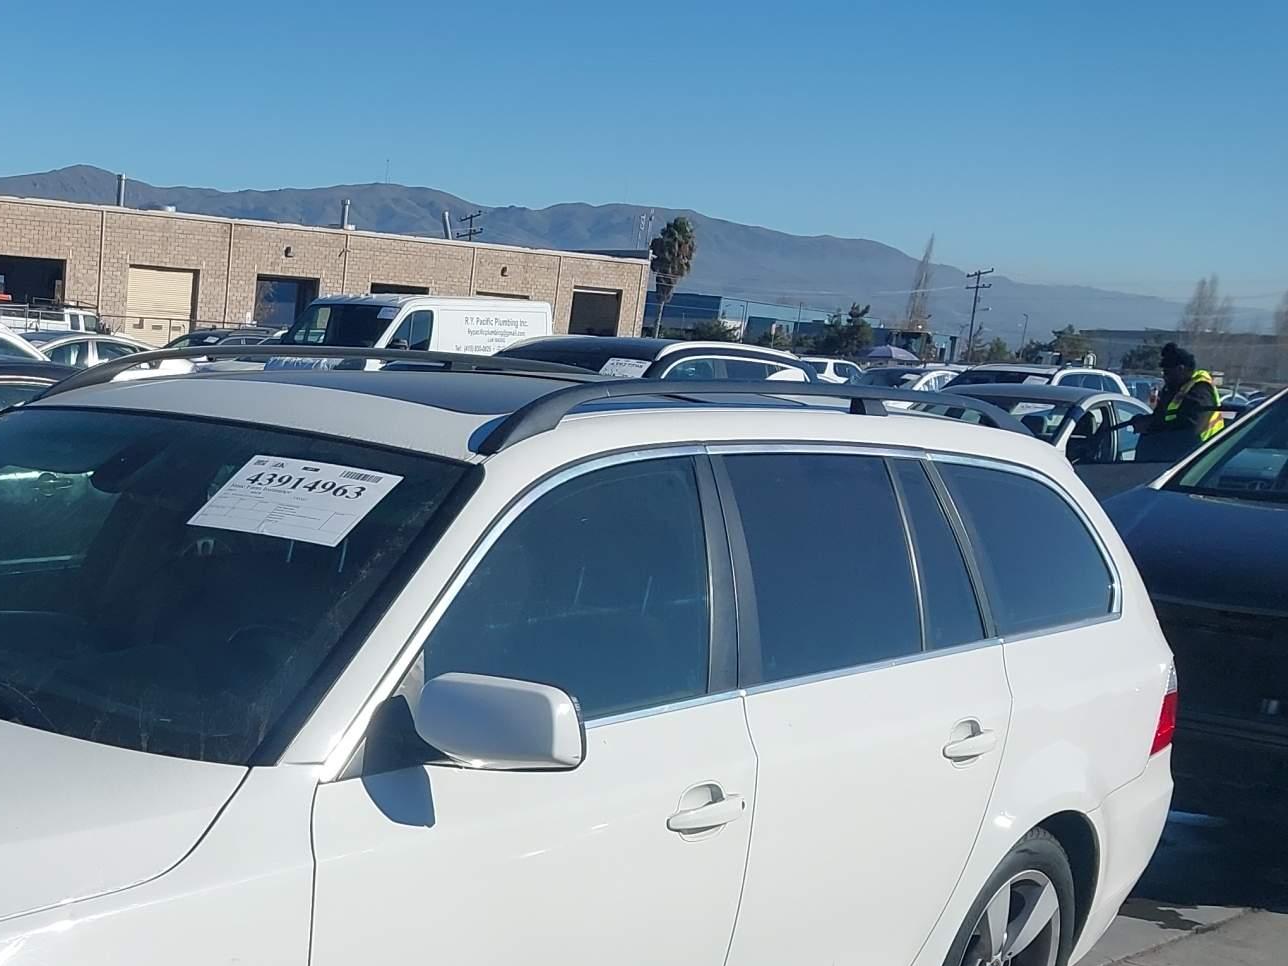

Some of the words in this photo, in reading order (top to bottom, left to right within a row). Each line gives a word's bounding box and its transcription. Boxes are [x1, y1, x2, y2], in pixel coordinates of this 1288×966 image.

[476, 316, 493, 326] Pacific
[494, 317, 519, 329] Plumbing
[246, 471, 367, 500] 43914963
